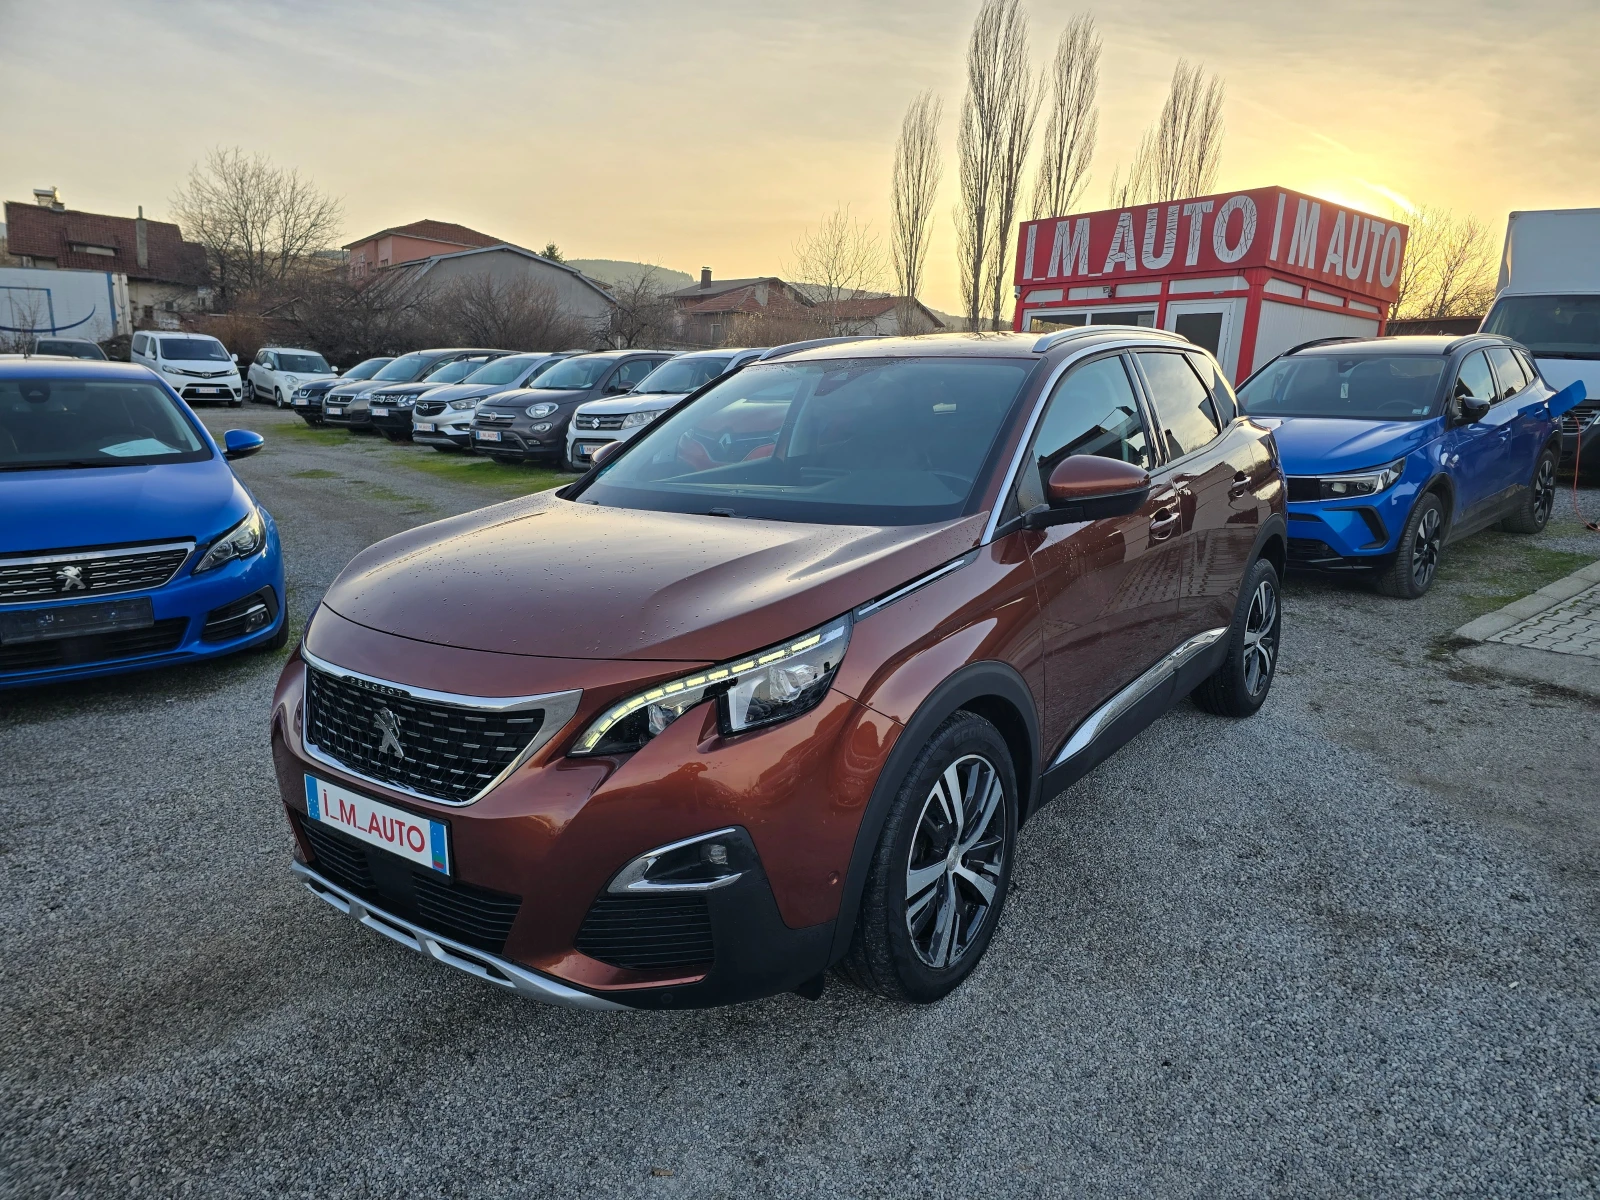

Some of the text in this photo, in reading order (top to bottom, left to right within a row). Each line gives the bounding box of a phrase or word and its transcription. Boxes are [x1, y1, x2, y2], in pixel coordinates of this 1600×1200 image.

[1023, 195, 1257, 281] I_M_AUTO
[1269, 193, 1401, 288] I M AUTO
[350, 677, 403, 697] PEUGEOT
